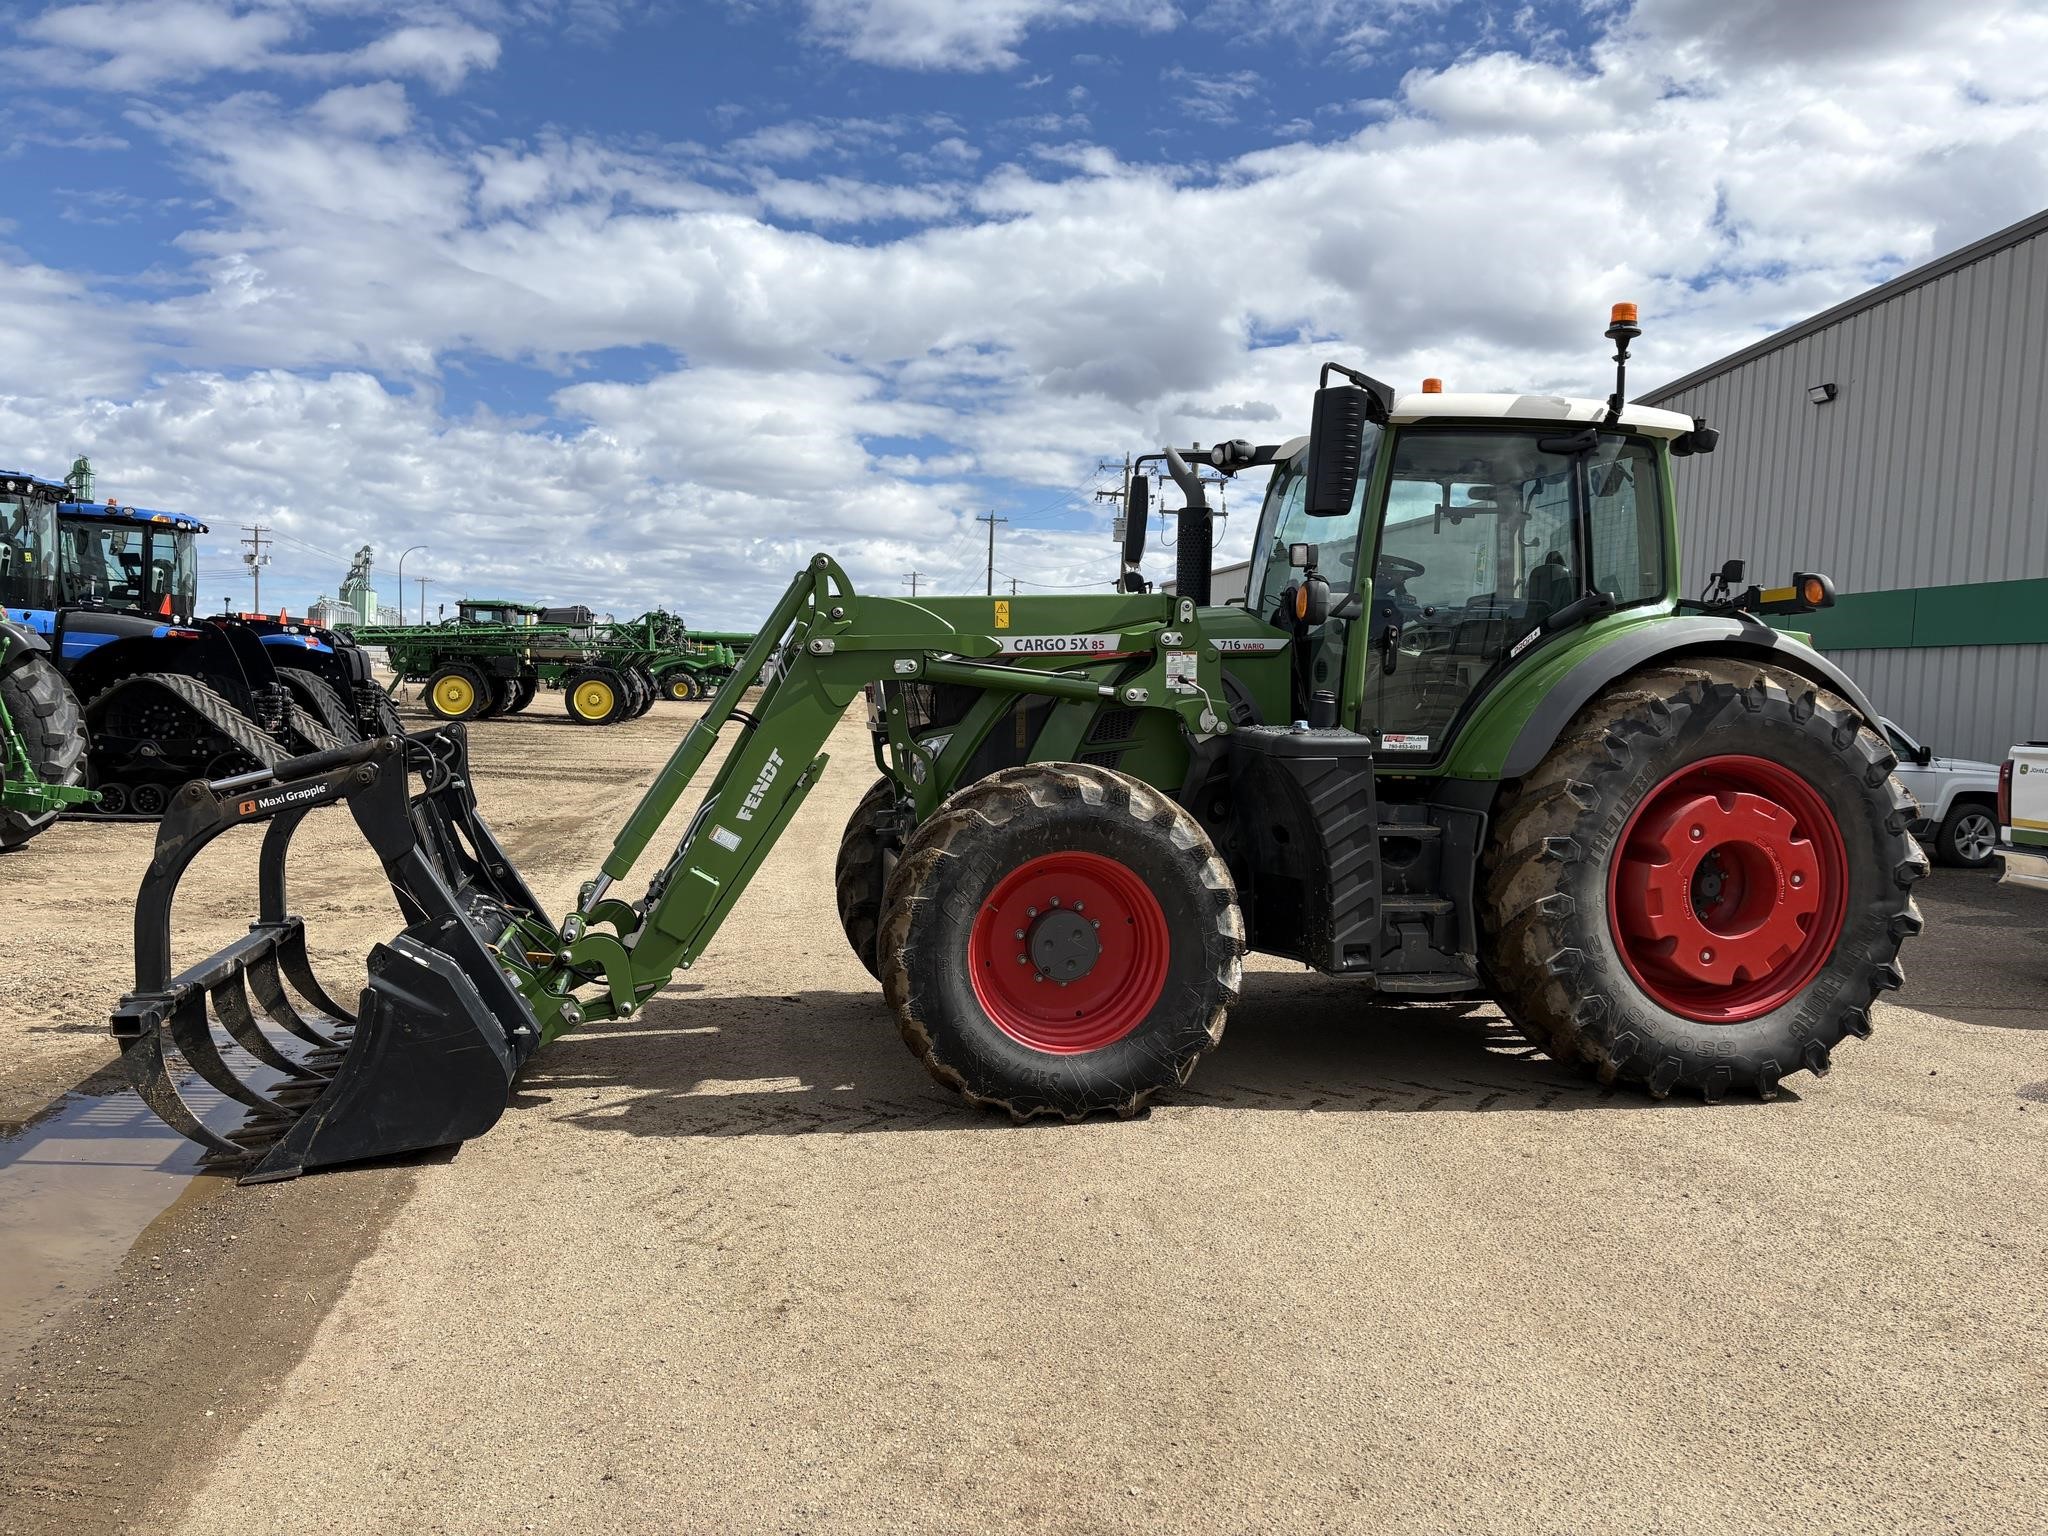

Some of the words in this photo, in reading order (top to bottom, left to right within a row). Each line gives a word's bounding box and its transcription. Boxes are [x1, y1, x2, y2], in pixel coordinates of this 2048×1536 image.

[1014, 638, 1066, 651] CARGO
[1070, 638, 1088, 650] 5X
[1091, 640, 1105, 650] 85
[1220, 640, 1241, 650] 716
[736, 747, 784, 821] FENDT
[258, 794, 285, 809] Maxi
